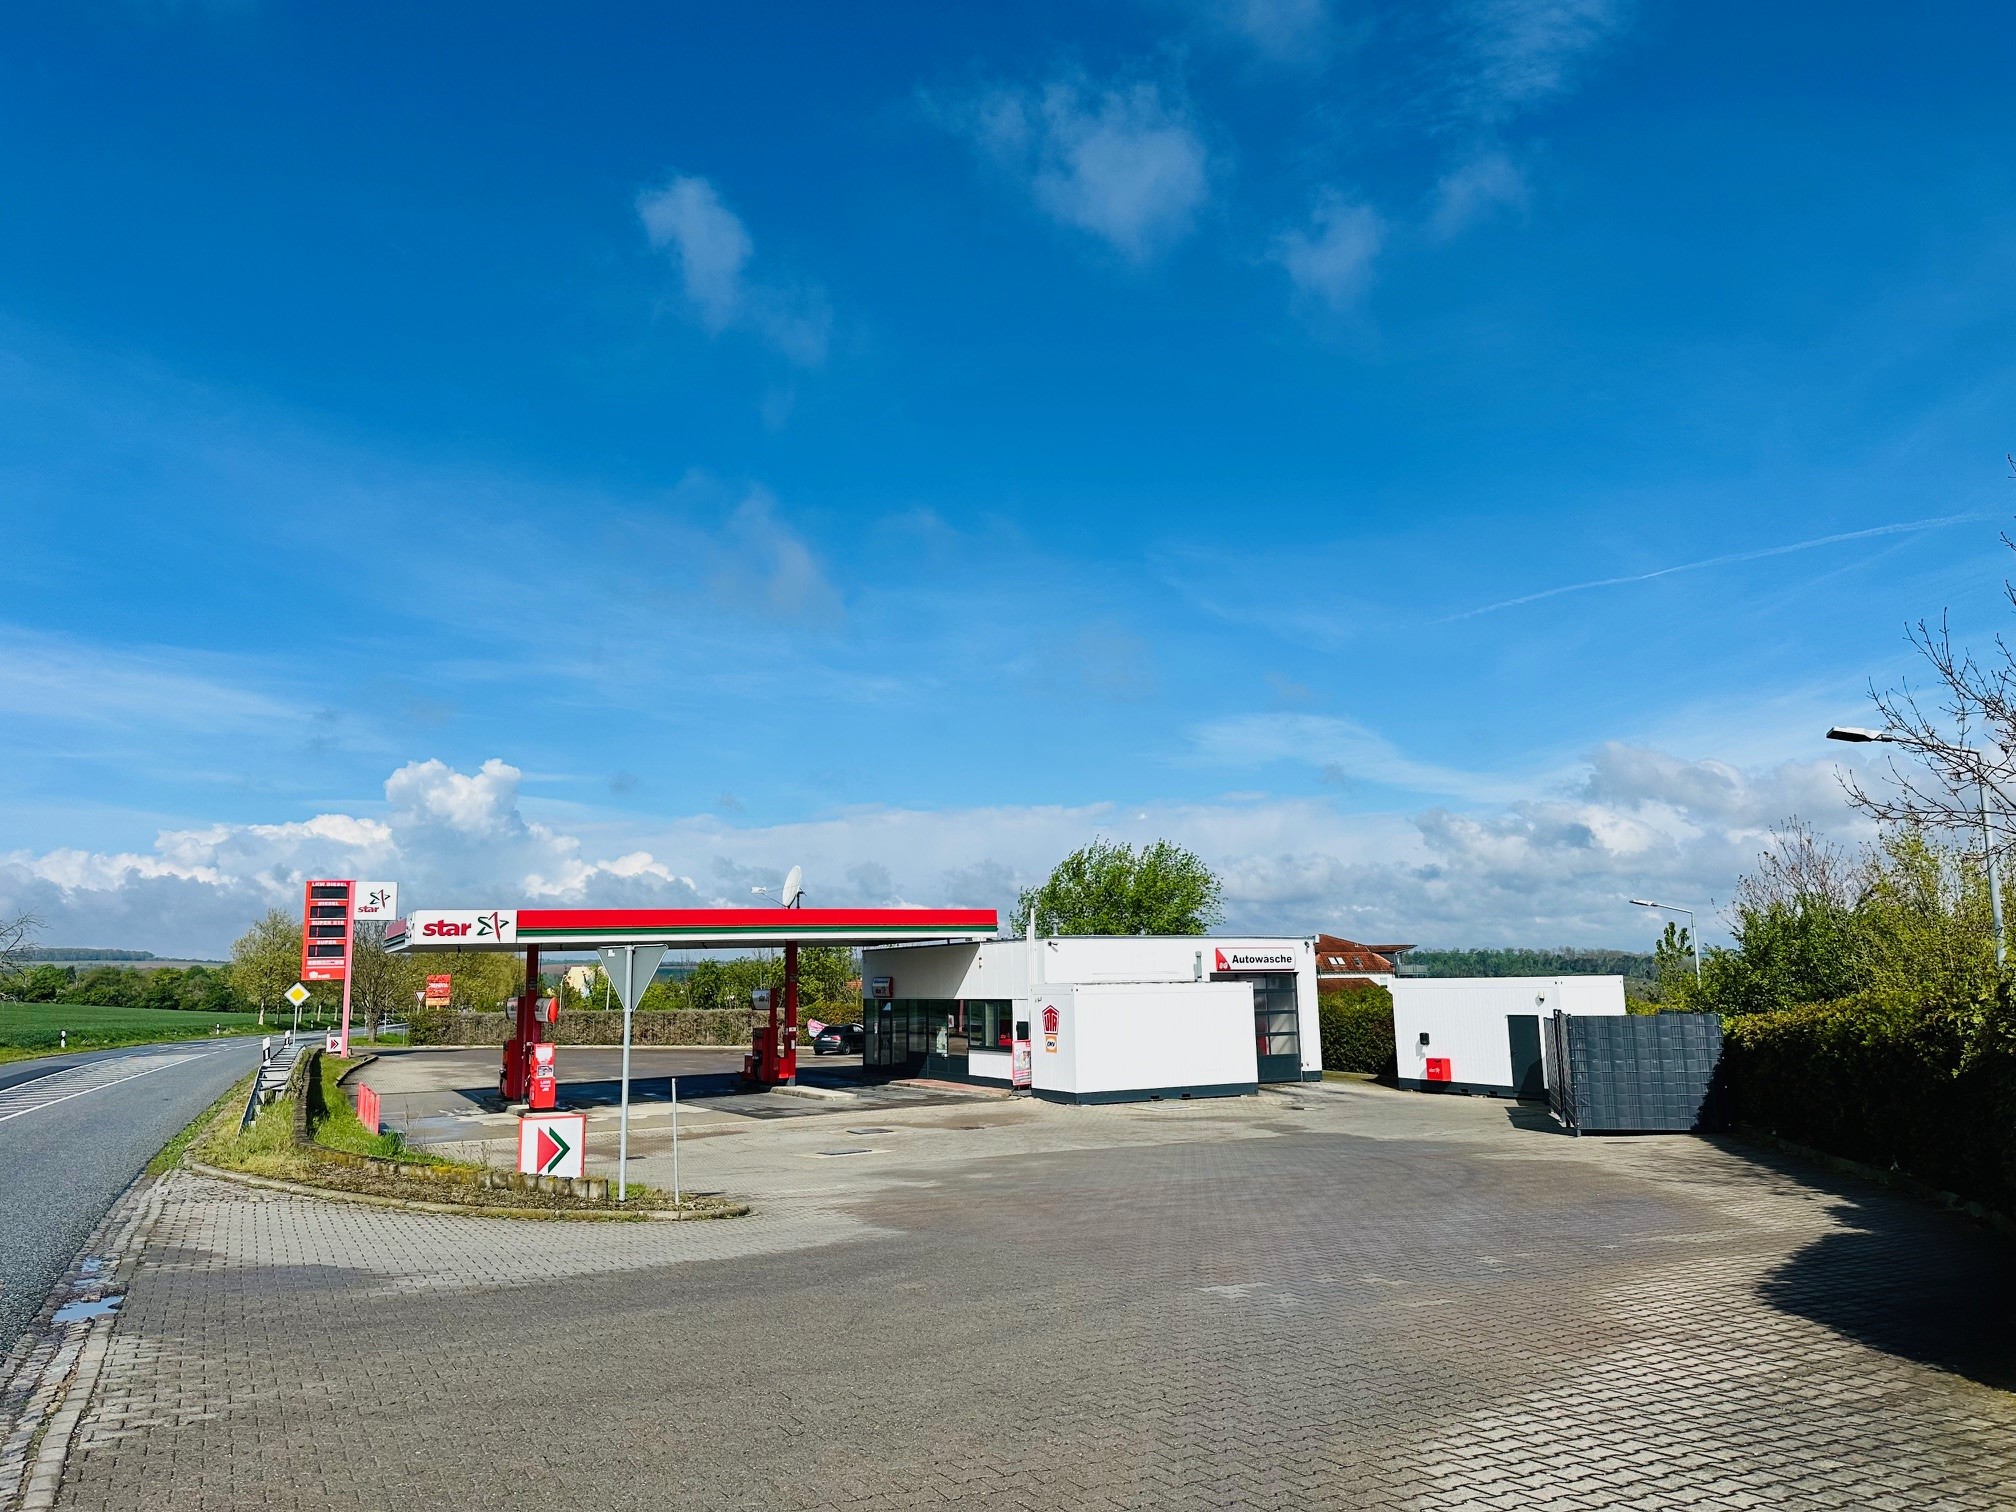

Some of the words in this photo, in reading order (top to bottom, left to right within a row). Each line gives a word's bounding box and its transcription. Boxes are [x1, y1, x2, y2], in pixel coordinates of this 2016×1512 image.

[358, 905, 379, 913] star
[422, 919, 472, 937] star
[1232, 954, 1292, 964] Autowäsche
